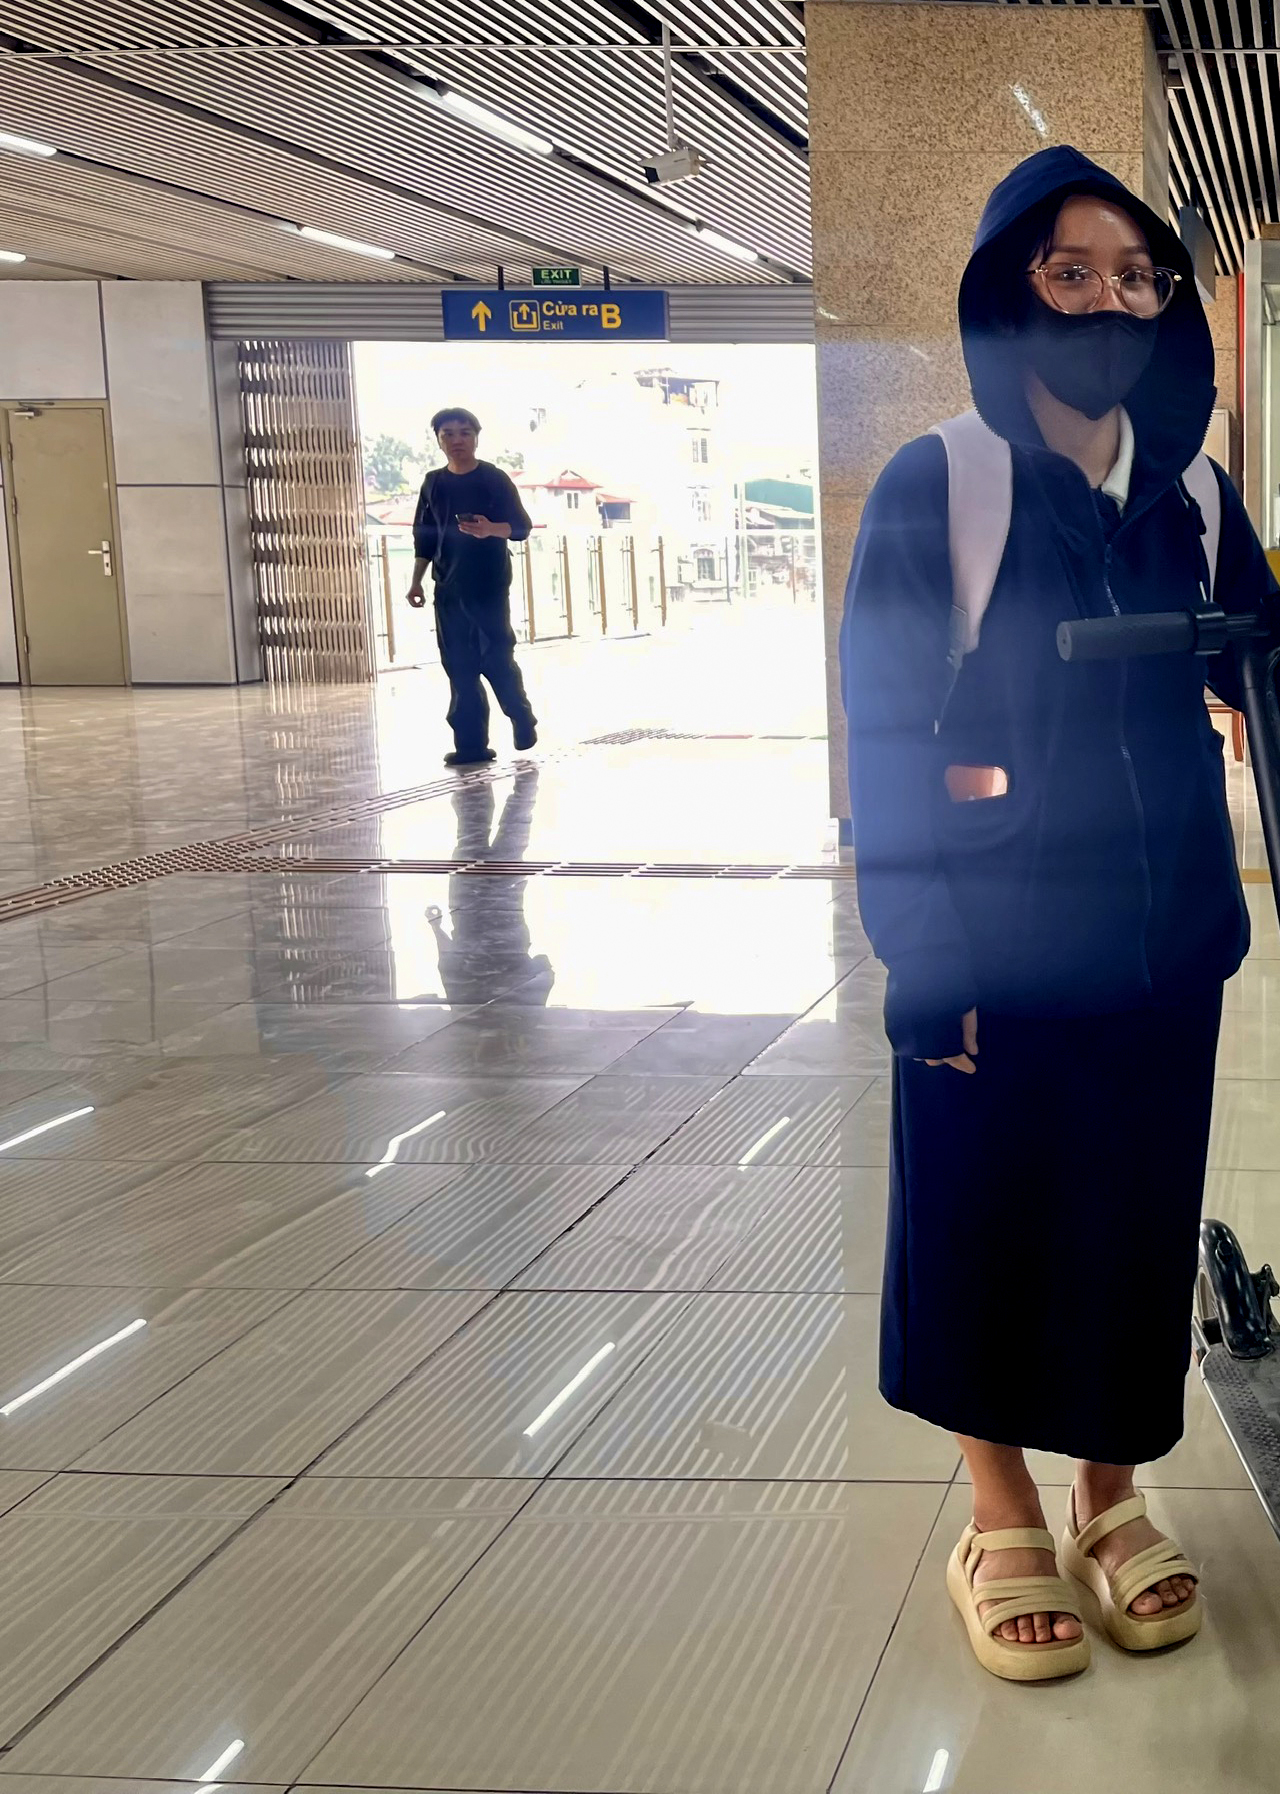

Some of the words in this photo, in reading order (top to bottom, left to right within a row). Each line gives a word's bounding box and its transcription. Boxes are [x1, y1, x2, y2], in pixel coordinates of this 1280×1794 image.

[541, 269, 572, 279] EXIT
[542, 300, 577, 316] Cửa
[582, 304, 599, 316] ra
[601, 303, 622, 329] B
[543, 320, 564, 331] Exit
